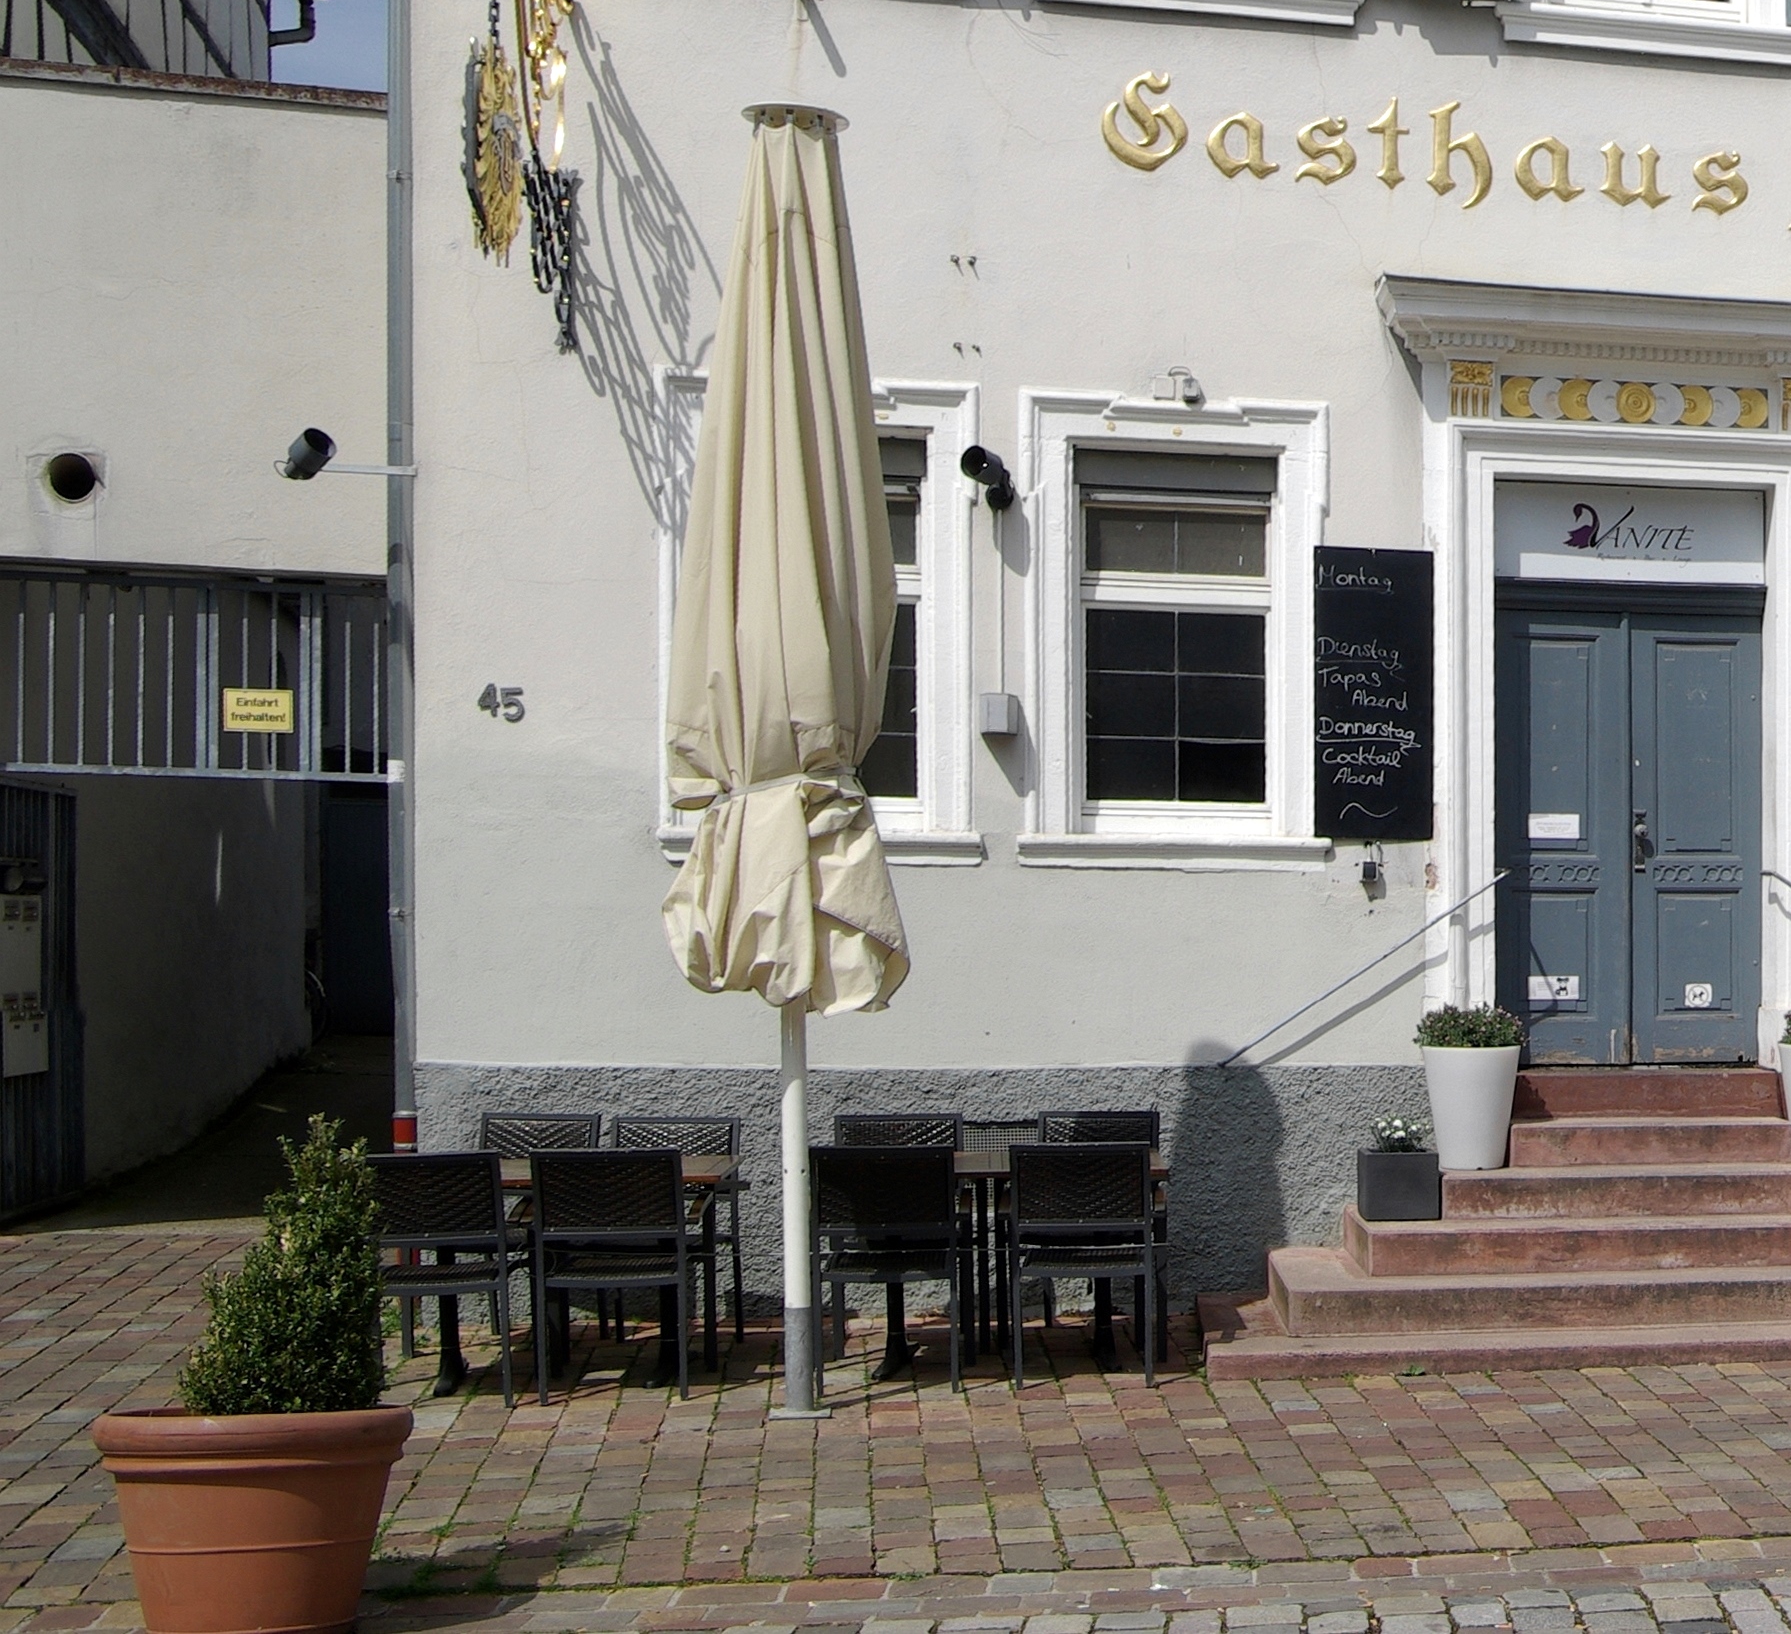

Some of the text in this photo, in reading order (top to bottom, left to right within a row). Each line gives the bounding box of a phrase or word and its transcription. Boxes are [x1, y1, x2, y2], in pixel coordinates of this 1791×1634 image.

[1099, 70, 1749, 216] Gasthaus
[1318, 564, 1394, 594] Montag
[1317, 637, 1402, 669] Dienstag
[1317, 666, 1382, 692] Tapas
[235, 697, 279, 708] Einfahrt
[477, 683, 526, 724] 45
[1352, 689, 1409, 711] Abend
[230, 711, 287, 723] freihalten!
[1319, 716, 1416, 746] Donnerstag
[1322, 746, 1402, 768] Cocktail
[1333, 767, 1385, 787] Abend
